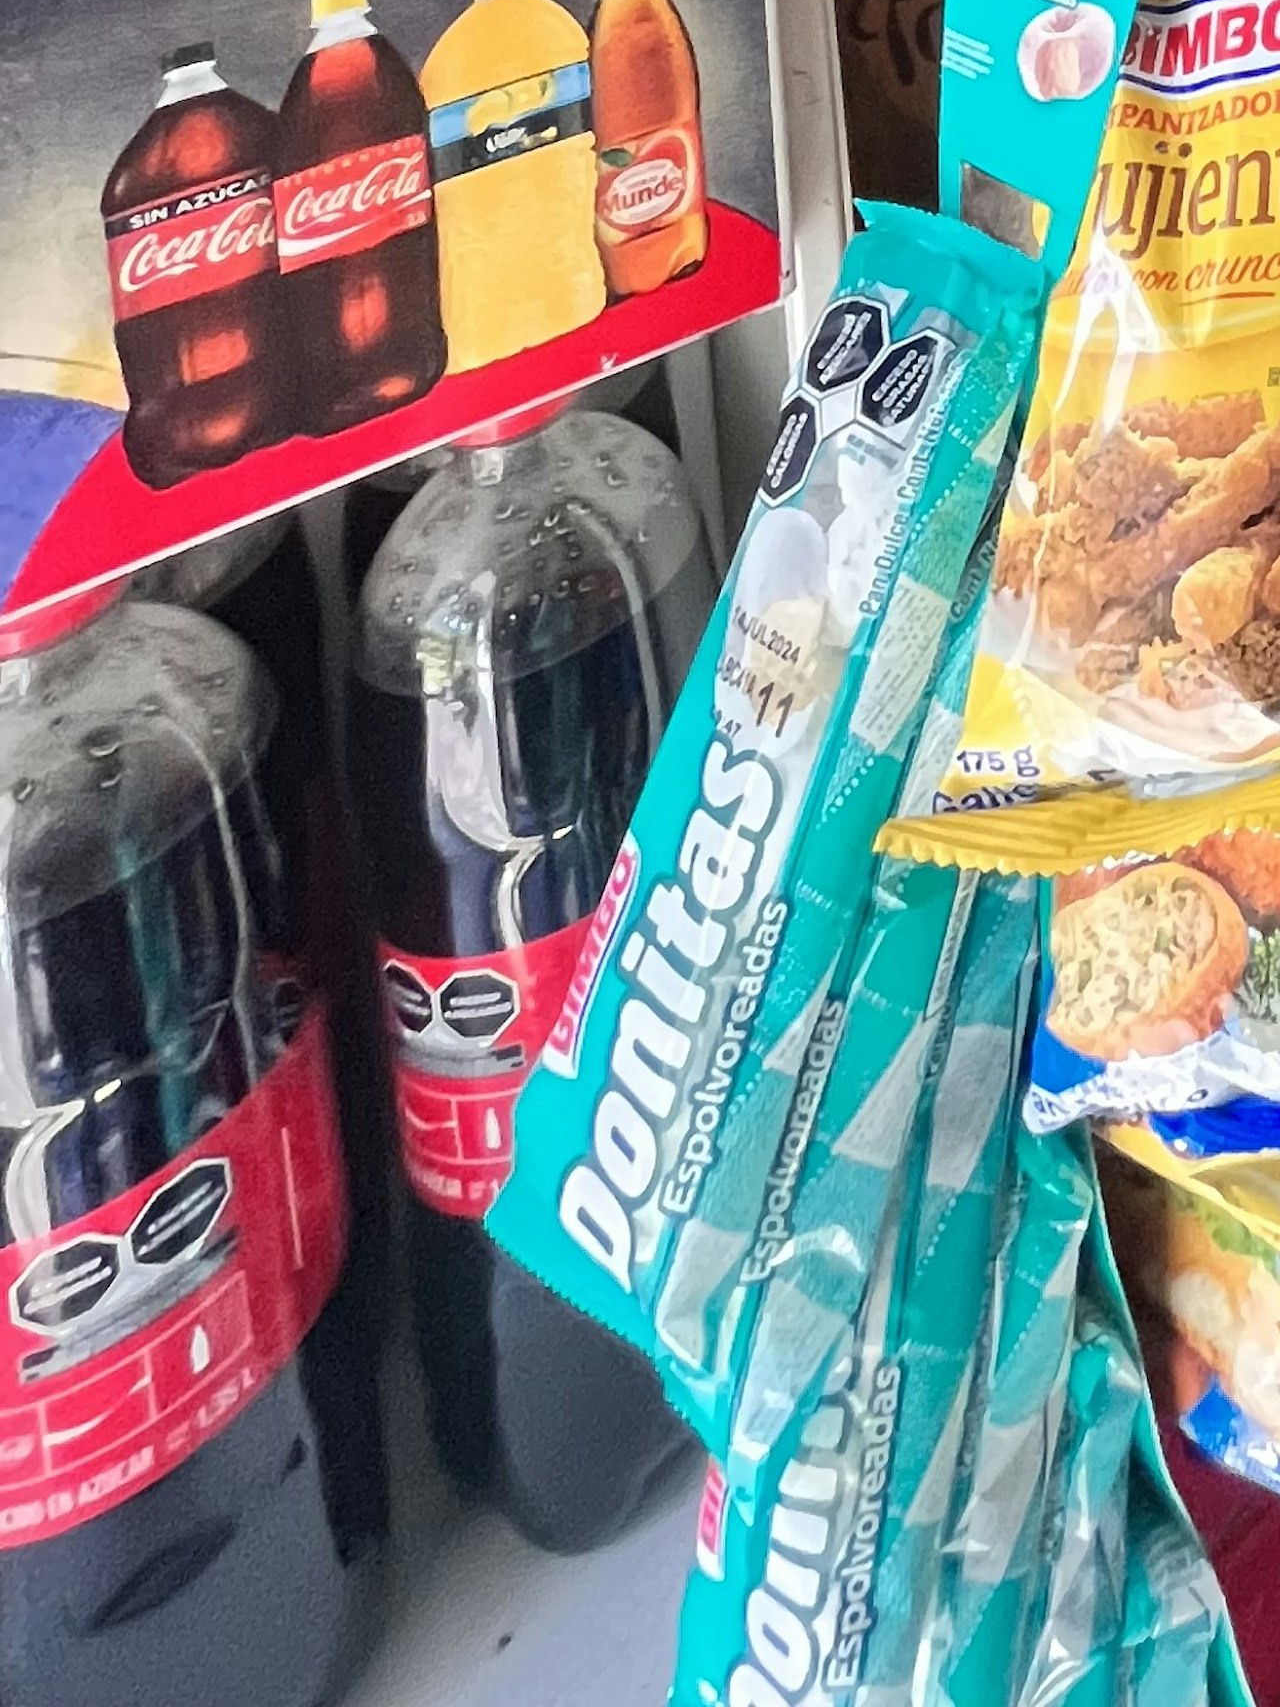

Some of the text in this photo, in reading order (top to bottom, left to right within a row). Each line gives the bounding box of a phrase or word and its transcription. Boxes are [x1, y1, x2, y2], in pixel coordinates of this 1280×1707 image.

[128, 202, 168, 232] SIN
[284, 150, 423, 236] Coca-Cola
[956, 745, 1041, 779] 175 g
[559, 740, 783, 1293] Donitas
[661, 895, 789, 1217] Espolvoreadas
[825, 1362, 904, 1689] Espolvoreadas
